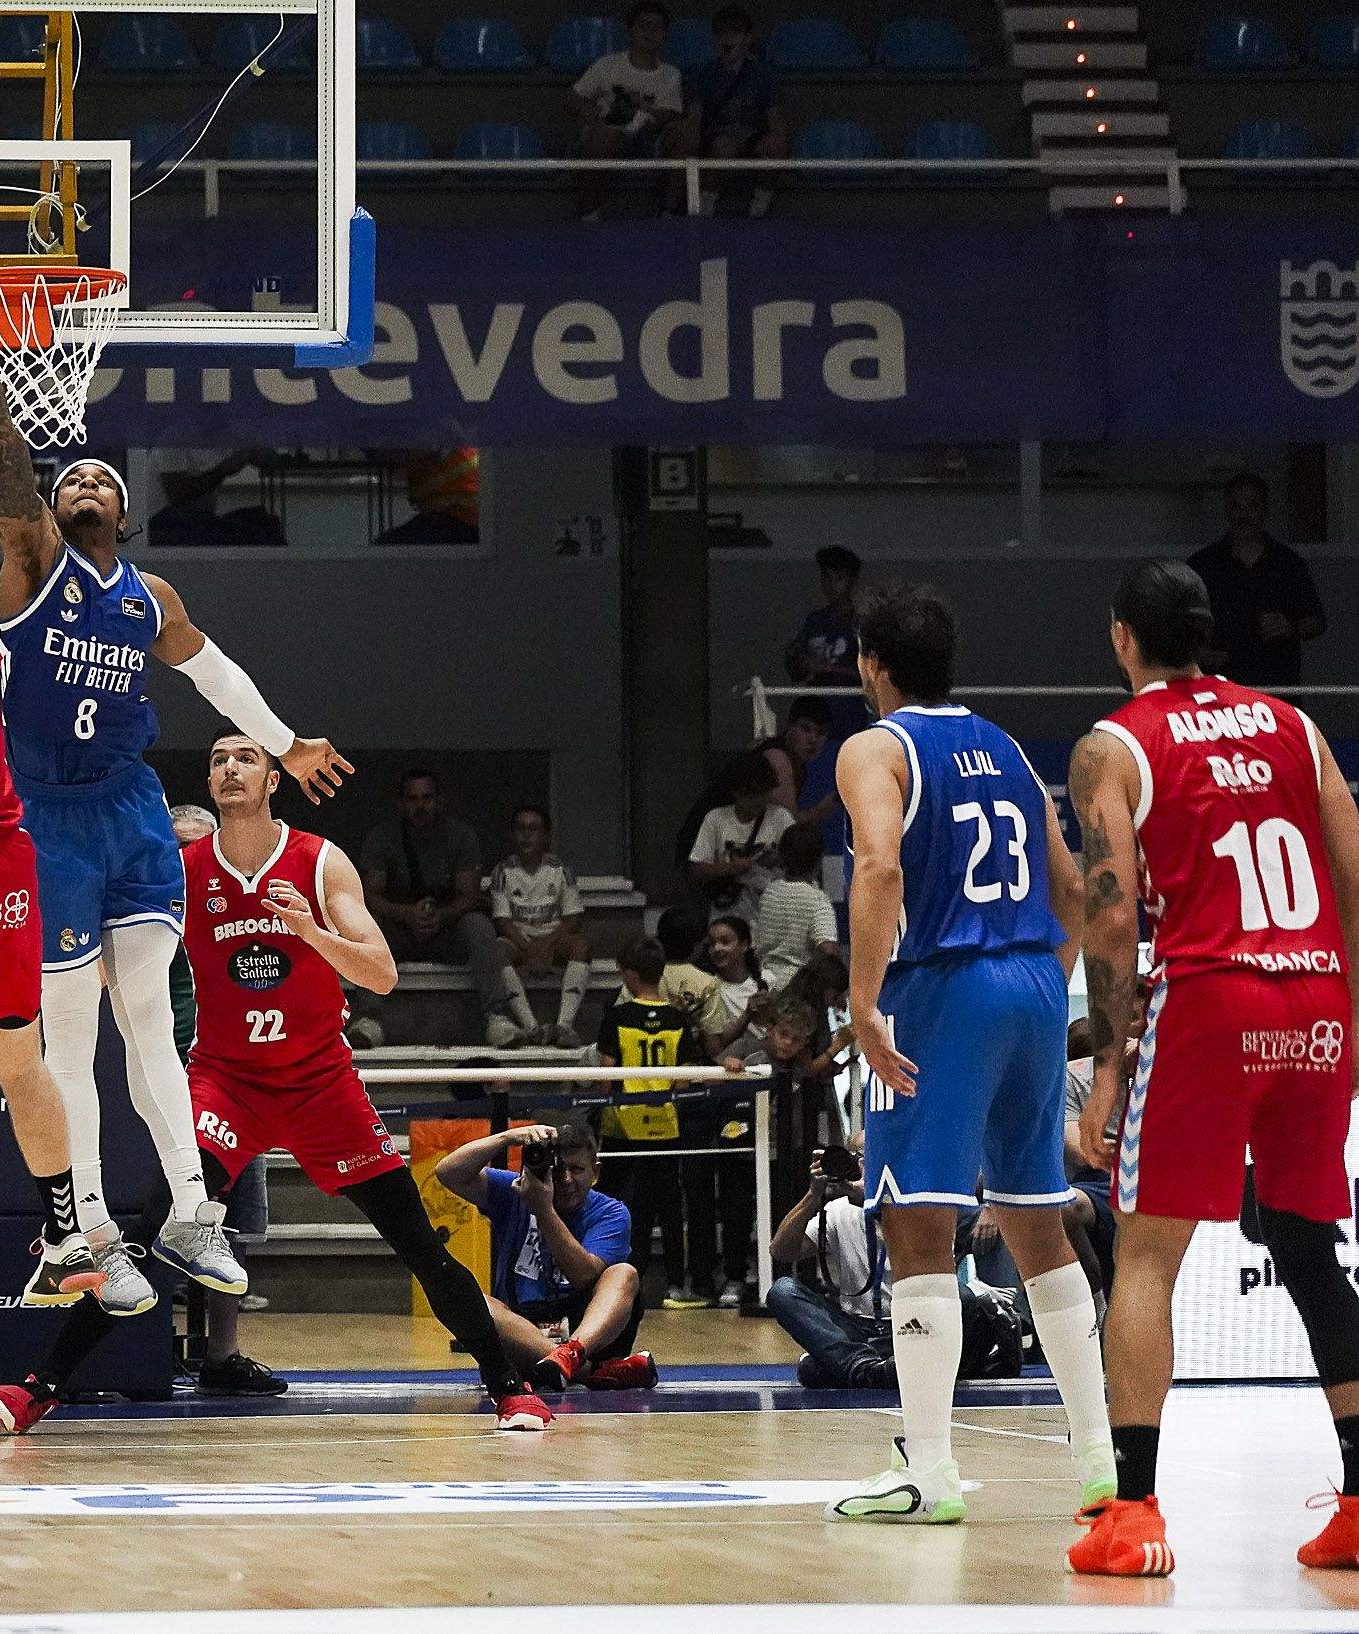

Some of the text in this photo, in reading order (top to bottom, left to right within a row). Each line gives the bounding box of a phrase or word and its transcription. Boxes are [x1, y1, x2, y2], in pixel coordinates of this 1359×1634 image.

[44, 627, 146, 672] Emirates
[55, 661, 132, 693] FLY BETTER
[74, 698, 98, 740] 8
[1166, 701, 1278, 745] ALONSO
[952, 800, 1030, 903] 23
[1212, 817, 1320, 932] 10
[236, 955, 280, 967] Estrella
[239, 966, 280, 979] Galicia
[246, 1010, 287, 1042] 22
